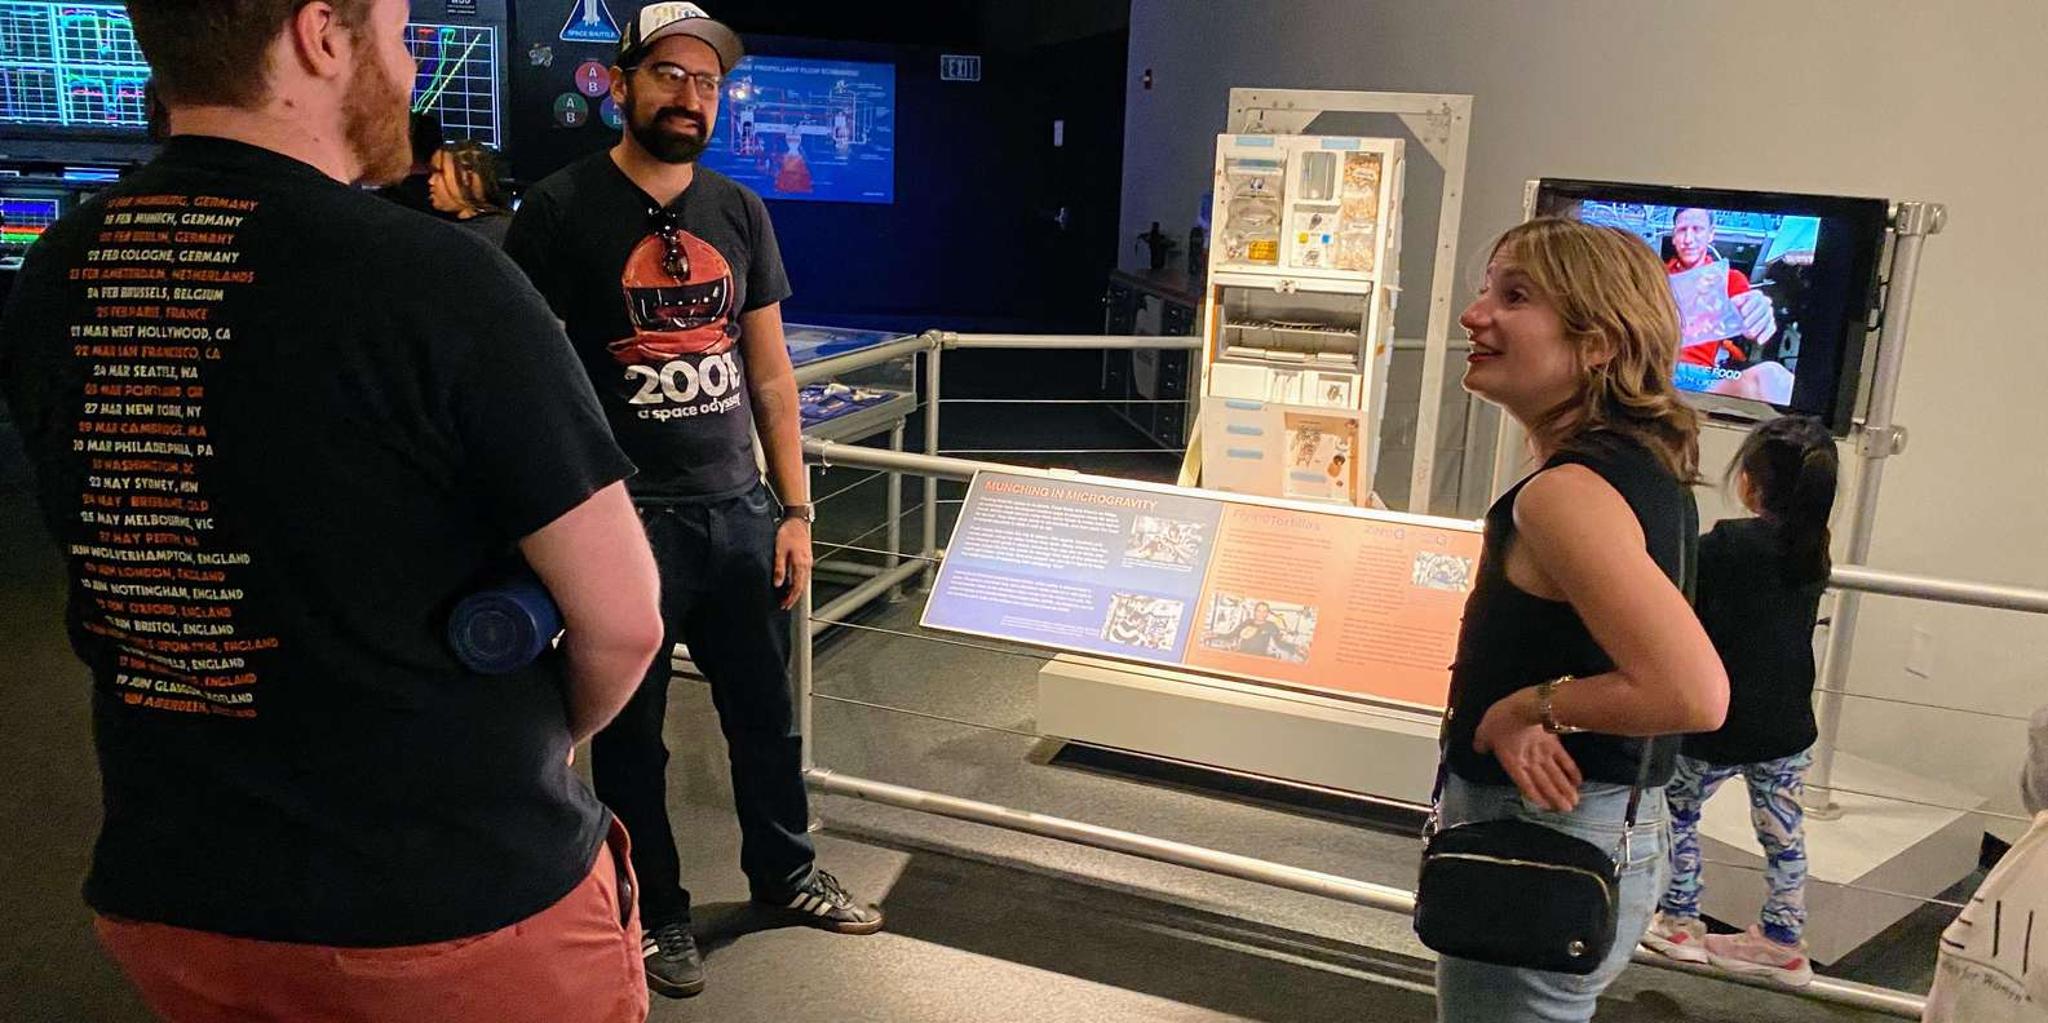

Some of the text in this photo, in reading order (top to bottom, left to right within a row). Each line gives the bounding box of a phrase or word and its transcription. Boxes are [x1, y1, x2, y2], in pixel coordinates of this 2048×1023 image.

[589, 67, 598, 77] A
[589, 82, 598, 92] B
[567, 97, 575, 108] A
[567, 113, 576, 123] B
[181, 213, 243, 227] GERMANY
[175, 232, 235, 244] GERMANY
[120, 250, 174, 263] COLOGNE,
[179, 251, 240, 263] GERMANY
[101, 287, 119, 298] FEB
[173, 288, 225, 300] BELGIUM
[165, 307, 209, 320] FRANCE
[83, 326, 109, 337] MAR
[111, 326, 135, 338] WEST
[137, 326, 212, 341] HOLLYWOOD,
[215, 328, 231, 340] CA
[205, 346, 221, 359] CA
[108, 365, 130, 376] MAR
[133, 365, 178, 380] SEATTLE,
[181, 366, 198, 378] WA
[623, 351, 742, 404] 2001
[1712, 367, 1742, 380] FOOD
[84, 403, 98, 414] 27
[100, 403, 122, 415] MAR
[126, 403, 154, 415] NEW
[187, 406, 201, 418] NY
[638, 410, 649, 420] a
[651, 404, 698, 423] space
[87, 439, 112, 452] MAR
[114, 440, 193, 457] PHILADELPHIA,
[197, 444, 214, 456] PA
[103, 476, 130, 489] MAY
[134, 477, 178, 493] SYDNEY,
[985, 480, 1160, 512] MUNCHING IN MICROGRAVITY
[97, 512, 120, 525] MAY
[124, 513, 193, 529] MELBOURNE,
[194, 518, 214, 529] VIC
[92, 545, 195, 565] WOLVERHAMPTON,
[197, 553, 250, 565] ENGLAND
[118, 566, 176, 580] LONDON,
[111, 583, 191, 599] NOTTINGHAM,
[192, 588, 243, 600] ENGLAND
[129, 602, 180, 617] OXFORD,
[134, 619, 181, 636] BRISTOL,
[183, 623, 234, 635] ENGLAND
[191, 658, 245, 670] ENGLAND
